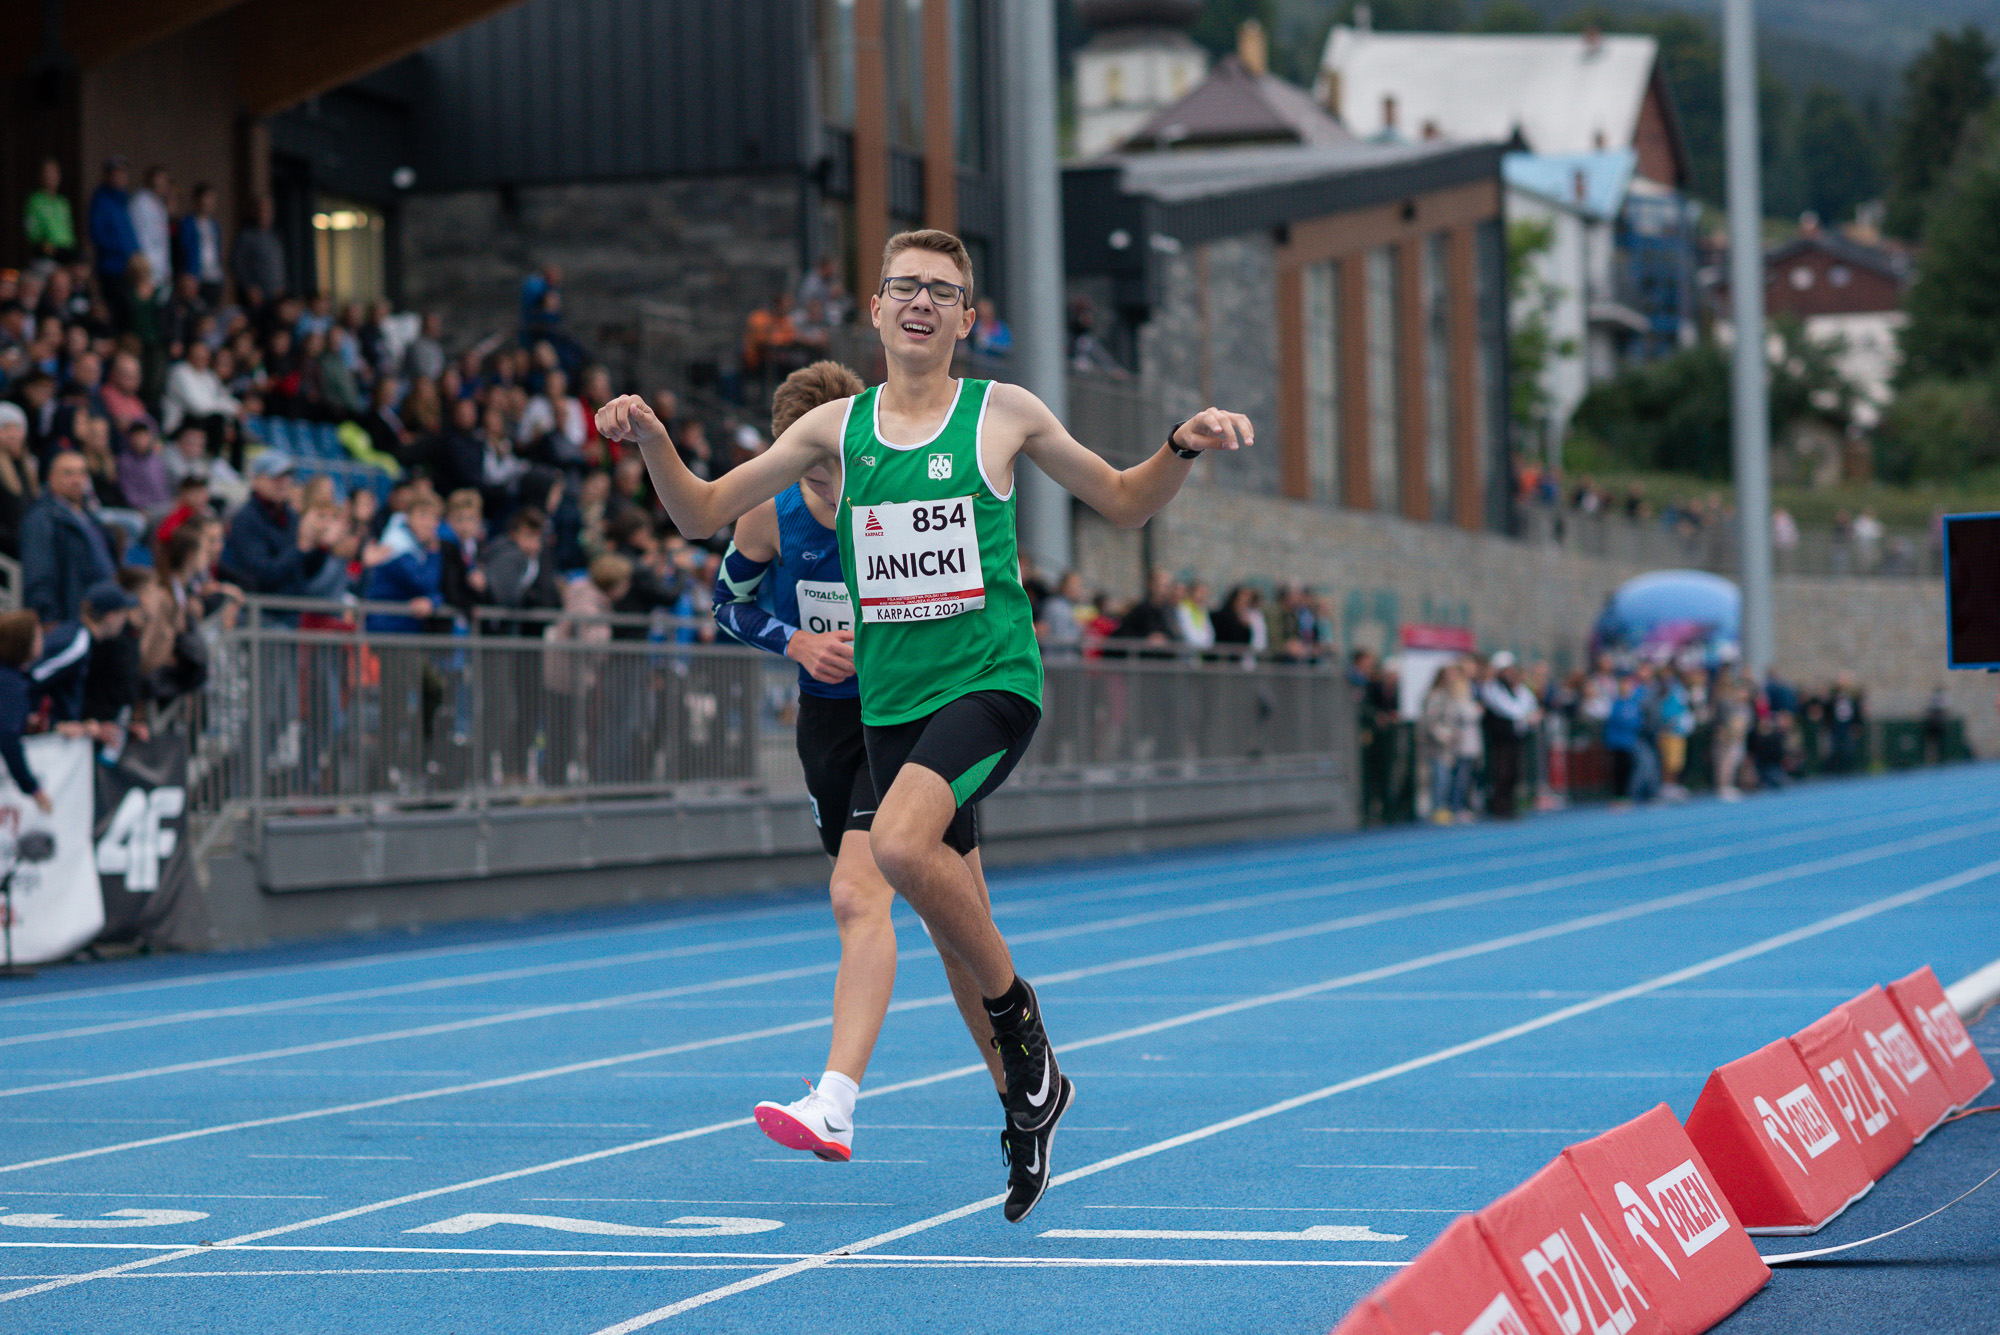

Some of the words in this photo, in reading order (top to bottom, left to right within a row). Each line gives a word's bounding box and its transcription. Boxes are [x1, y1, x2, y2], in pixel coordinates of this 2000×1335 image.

[912, 503, 967, 533] 854
[866, 547, 966, 581] JANICKI
[804, 588, 849, 601] TOTALbet
[876, 606, 931, 620] KARPACZ
[934, 602, 965, 616] 2021
[97, 786, 186, 892] 4F
[1819, 1048, 1898, 1144] PZLA
[1786, 1094, 1833, 1148] ORLEN
[1658, 1172, 1721, 1243] ORLEN
[400, 1213, 786, 1237] 2
[1036, 1225, 1409, 1241] 1
[1521, 1212, 1650, 1335] PZLA
